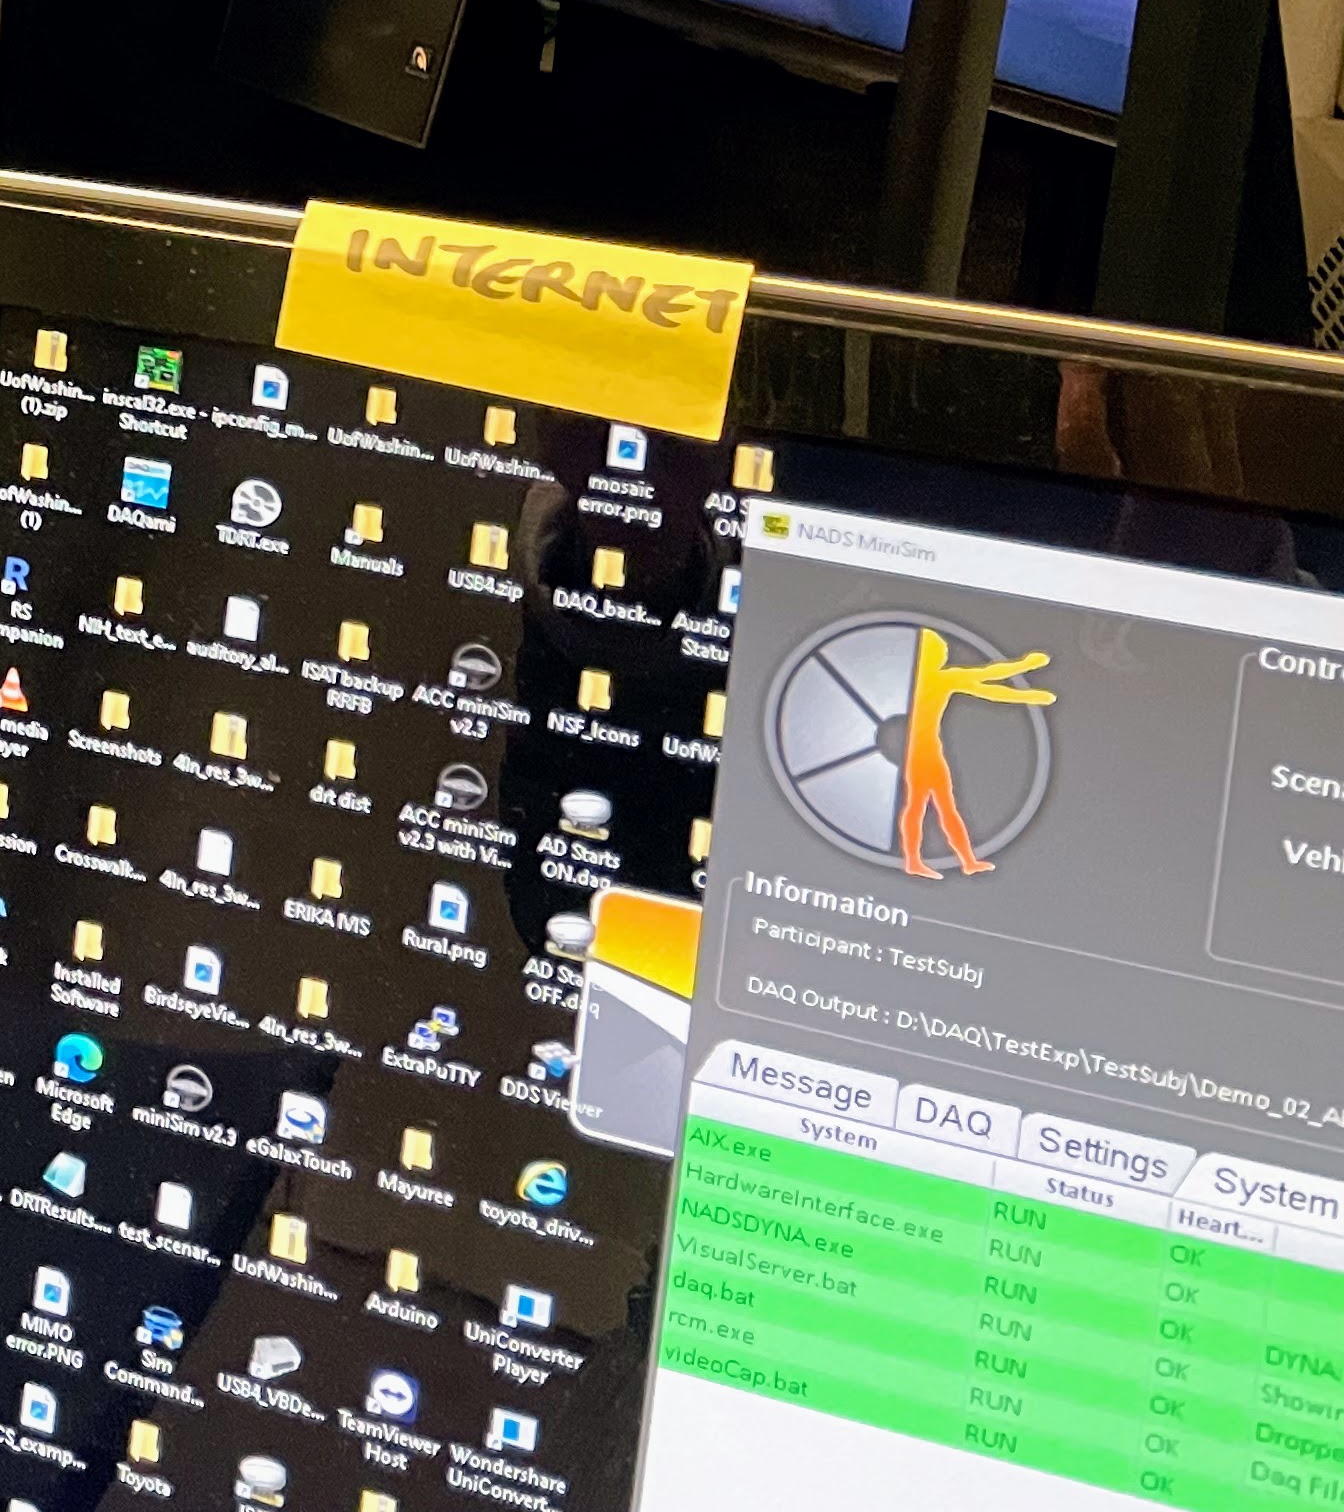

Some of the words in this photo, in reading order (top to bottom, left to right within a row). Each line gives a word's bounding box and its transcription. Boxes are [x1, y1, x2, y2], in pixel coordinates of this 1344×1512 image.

[346, 228, 739, 334] INTERNET
[119, 412, 188, 441] Shortcut
[589, 474, 655, 500] mosaic
[705, 493, 736, 514] AD
[578, 495, 663, 528] error.png
[330, 547, 404, 577] Manuals
[797, 522, 855, 550] NADS
[857, 533, 937, 565] MiniSim
[448, 569, 523, 602] USB4.zip
[11, 601, 33, 621] RS
[553, 589, 662, 627] DAQ_back...
[671, 609, 730, 639] Audio
[341, 665, 405, 701] backup
[1258, 646, 1344, 681] Contr
[412, 685, 454, 710] ACC
[456, 698, 531, 726] miniSim
[0, 718, 50, 741] media
[449, 716, 489, 739] v2.3
[67, 728, 163, 767] Screenshots
[338, 791, 372, 815] dist
[398, 803, 441, 830] ACC
[442, 817, 518, 847] miniSim
[398, 829, 435, 852] v2.3
[437, 837, 478, 860] with
[537, 834, 568, 859] AD
[571, 843, 621, 870] Starts
[284, 897, 336, 928] ERIKA
[337, 911, 372, 937] MS
[743, 870, 910, 928] Information
[402, 926, 489, 970] Rural.png
[752, 918, 871, 963] Participant
[889, 949, 985, 988] TestSubj
[54, 961, 122, 996] Installed
[523, 958, 554, 981] AD
[51, 984, 120, 1019] Software
[748, 976, 798, 1005] DAQ
[803, 990, 879, 1024] Output
[382, 1045, 482, 1088] ExtraPuTTY
[36, 1076, 115, 1115] Microsoft
[500, 1077, 541, 1104] DDS
[51, 1102, 92, 1132] Edge
[132, 1105, 201, 1139] miniSim
[202, 1124, 238, 1148] v2.3
[731, 1052, 872, 1111] Message
[915, 1097, 993, 1141] DAQ
[1039, 1126, 1170, 1182] Settings
[1215, 1167, 1340, 1219] System
[245, 1138, 352, 1181] eGalaxTouch
[378, 1170, 455, 1208] Mayuree
[689, 1126, 772, 1163] AIX.exe
[993, 1200, 1047, 1231] RUN
[1170, 1244, 1206, 1268] OK
[800, 1117, 878, 1152] System
[1045, 1178, 1115, 1208] Status
[1178, 1209, 1264, 1244] Heart...
[479, 1200, 594, 1246] toyota_driv...
[685, 1161, 944, 1244] HardwareInterface.exe
[989, 1237, 1043, 1269] RUN
[1165, 1281, 1200, 1305] OK
[681, 1197, 854, 1259] NADSDYNA.exe
[984, 1275, 1037, 1305] RUN
[1159, 1319, 1194, 1344] OK
[365, 1292, 440, 1331] Arduino
[676, 1233, 858, 1298] VisualServer.bat
[979, 1312, 1032, 1342] RUN
[1155, 1357, 1190, 1381] OK
[20, 1311, 74, 1344] MIMO
[463, 1320, 585, 1372] UniConverter
[673, 1272, 756, 1308] daq.bat
[974, 1349, 1027, 1380] RUN
[1149, 1394, 1185, 1420] OK
[6, 1333, 84, 1370] error.PNG
[141, 1348, 174, 1376] Sim
[492, 1352, 552, 1387] Player
[104, 1360, 205, 1410] Command...
[668, 1310, 756, 1346] rcm.exe
[969, 1387, 1023, 1417] RUN
[1144, 1432, 1179, 1458] OK
[1250, 1460, 1301, 1496] Daq
[336, 1407, 442, 1458] TeamViewer
[664, 1344, 808, 1398] videoCap.bat
[964, 1423, 1018, 1454] RUN
[1140, 1470, 1175, 1496] OK
[363, 1442, 409, 1472] Host
[449, 1443, 568, 1496] Wondershare
[116, 1462, 173, 1499] Toyota
